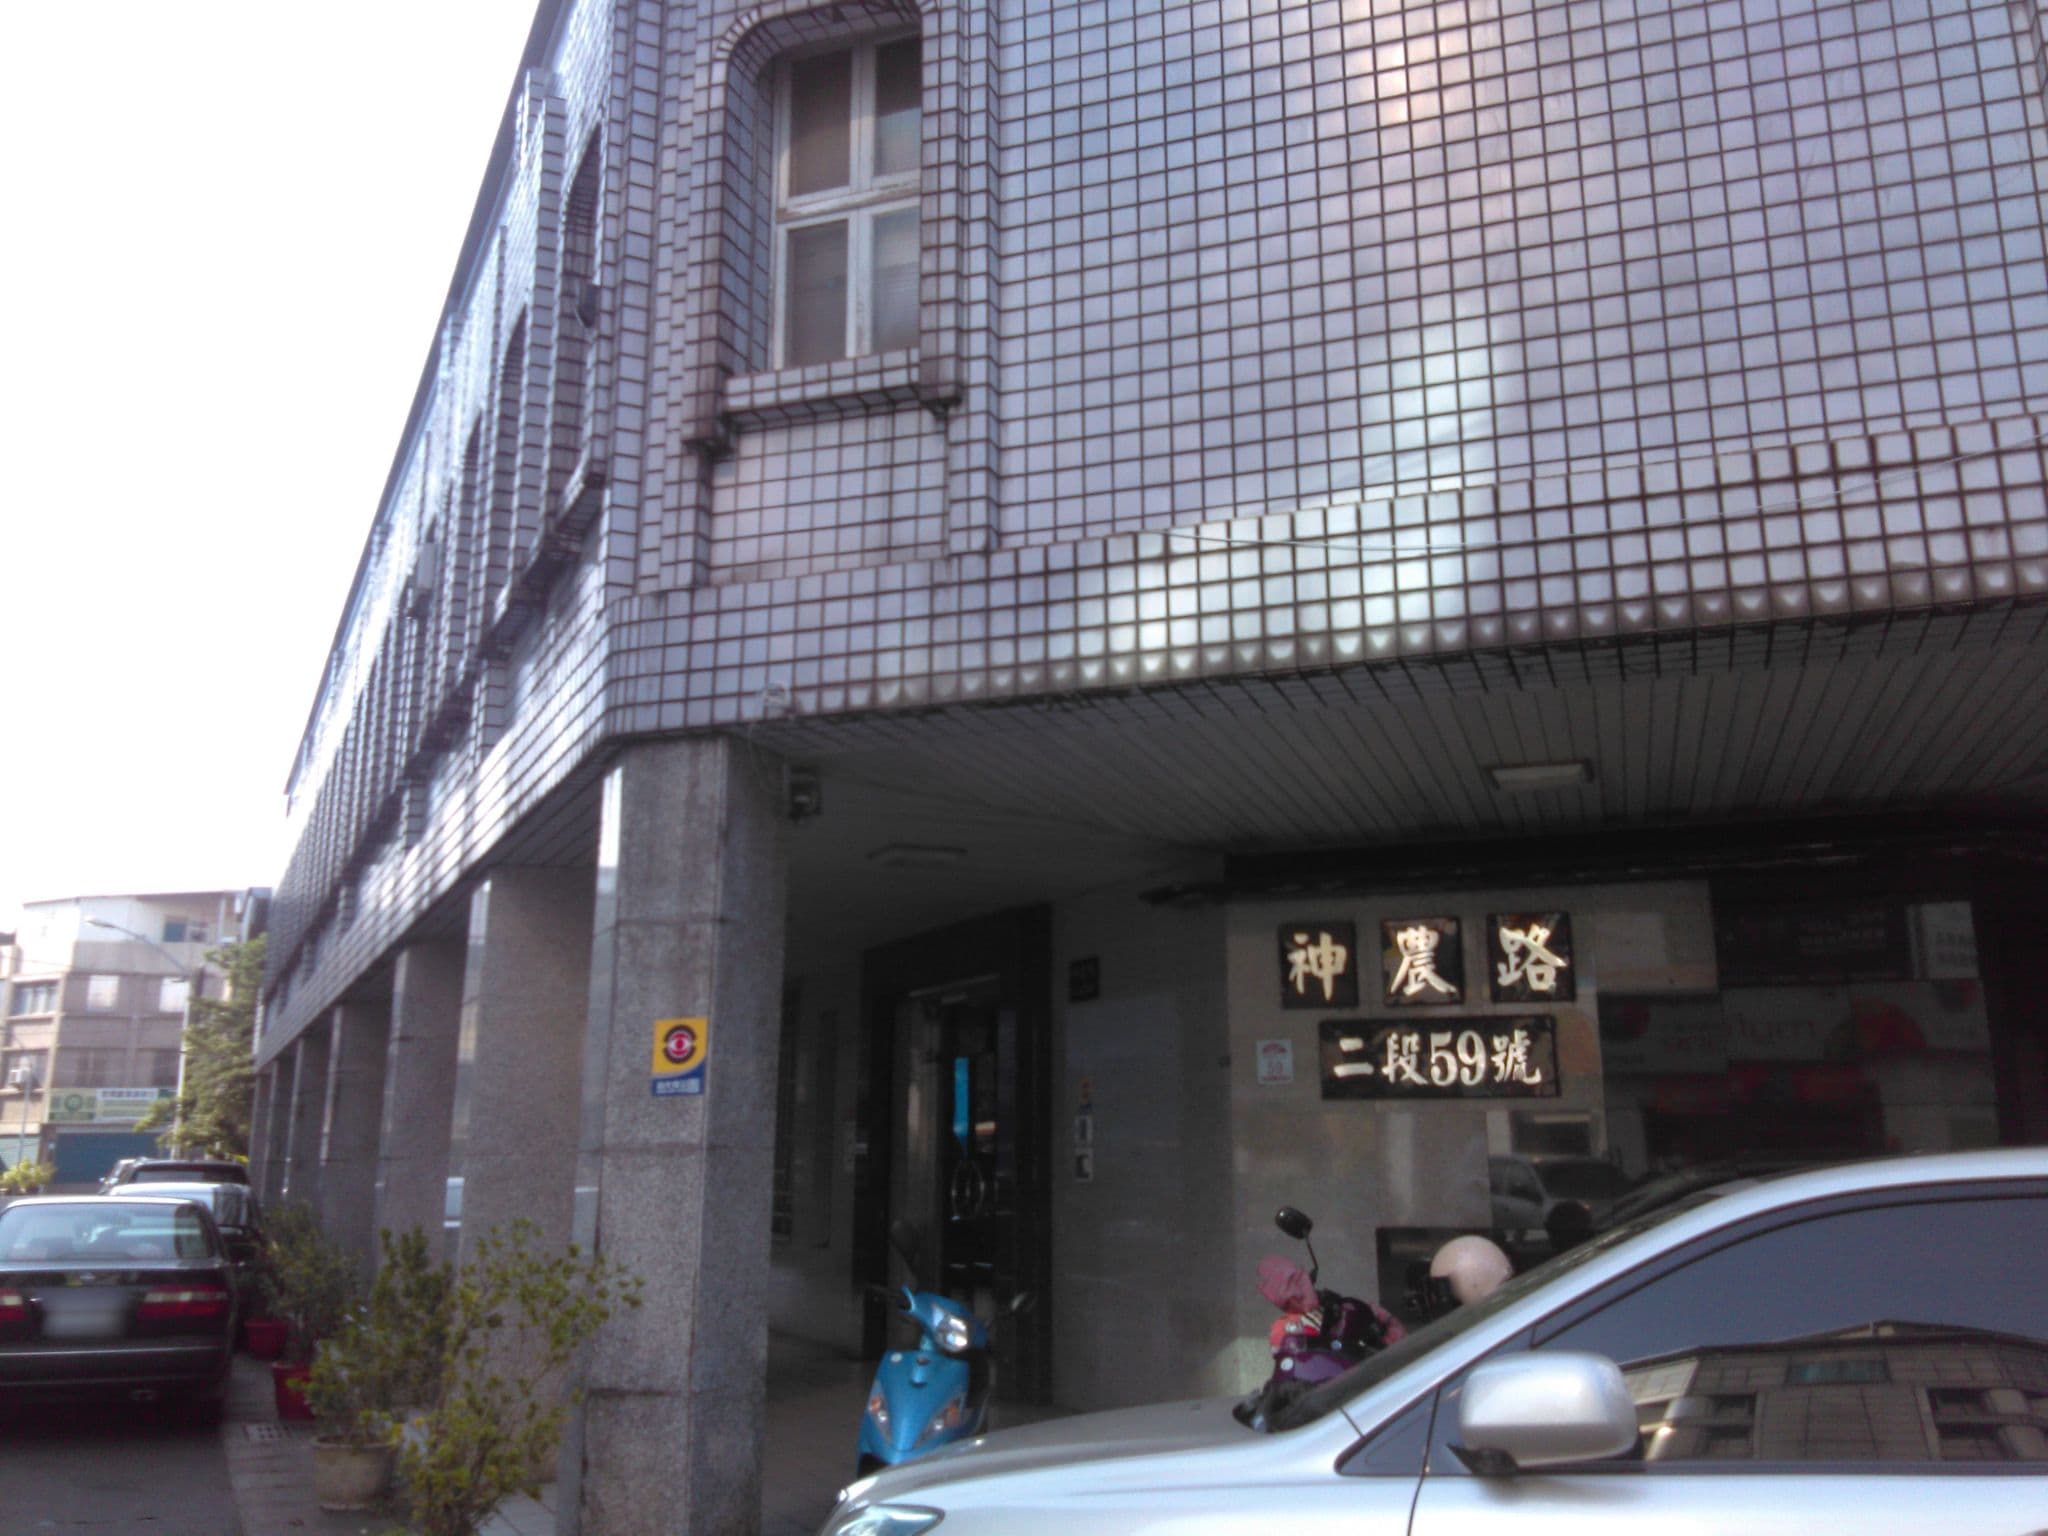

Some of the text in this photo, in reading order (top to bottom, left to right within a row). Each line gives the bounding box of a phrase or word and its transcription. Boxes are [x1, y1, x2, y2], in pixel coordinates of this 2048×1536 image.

[1288, 923, 1568, 1001] 神農路
[1333, 1029, 1543, 1087] 二段59號
